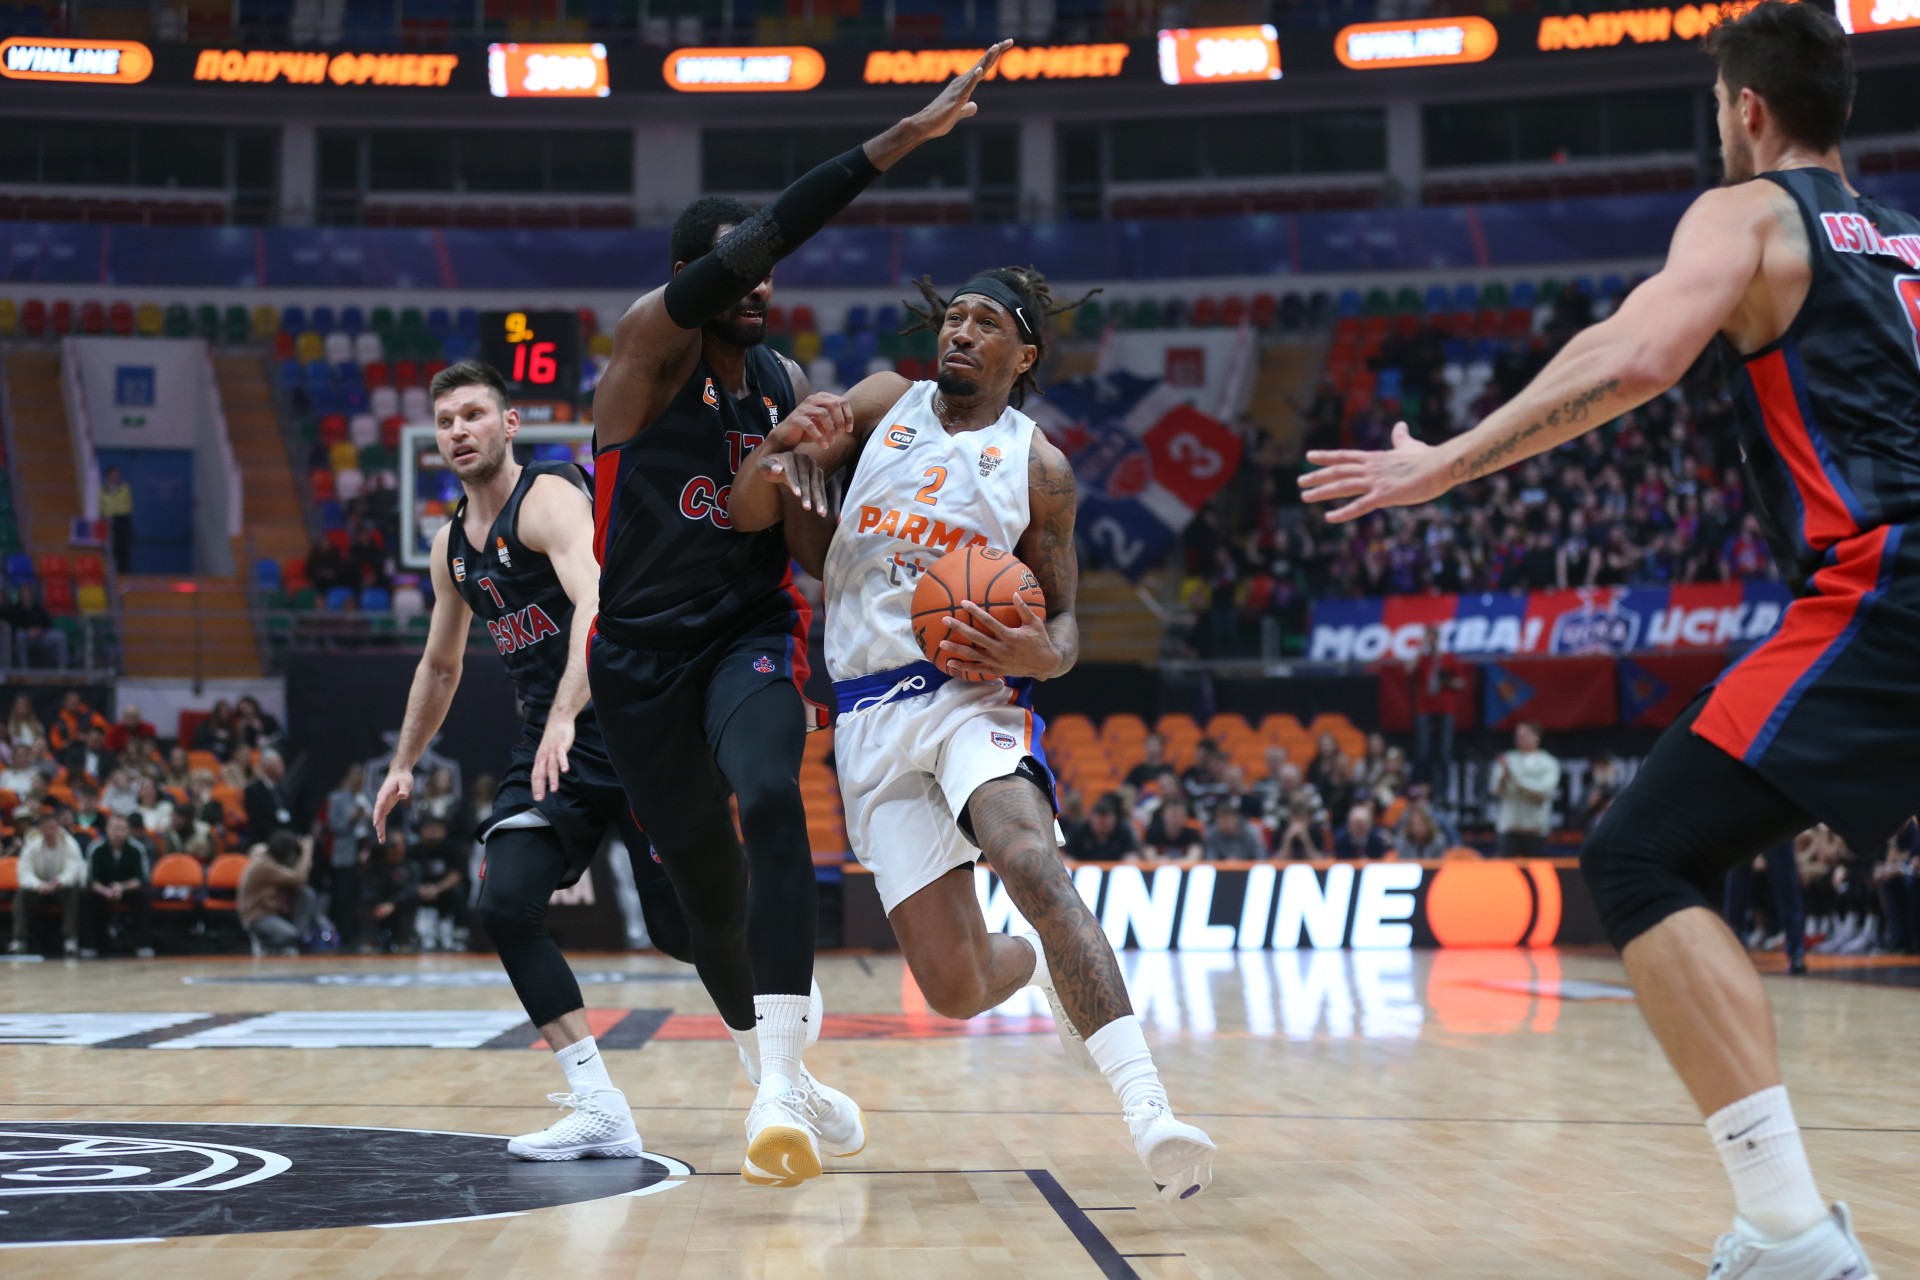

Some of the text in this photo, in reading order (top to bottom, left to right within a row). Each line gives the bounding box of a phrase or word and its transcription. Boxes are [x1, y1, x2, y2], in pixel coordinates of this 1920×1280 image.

[8, 46, 120, 75] WINLINE
[194, 49, 329, 84] ПОЛУЧИ
[512, 341, 557, 384] 16
[893, 432, 914, 443] WIN
[914, 466, 947, 506] 2
[980, 469, 990, 477] CUP
[679, 475, 732, 529] CS
[858, 505, 988, 553] PARMA
[487, 604, 560, 655] CSKA
